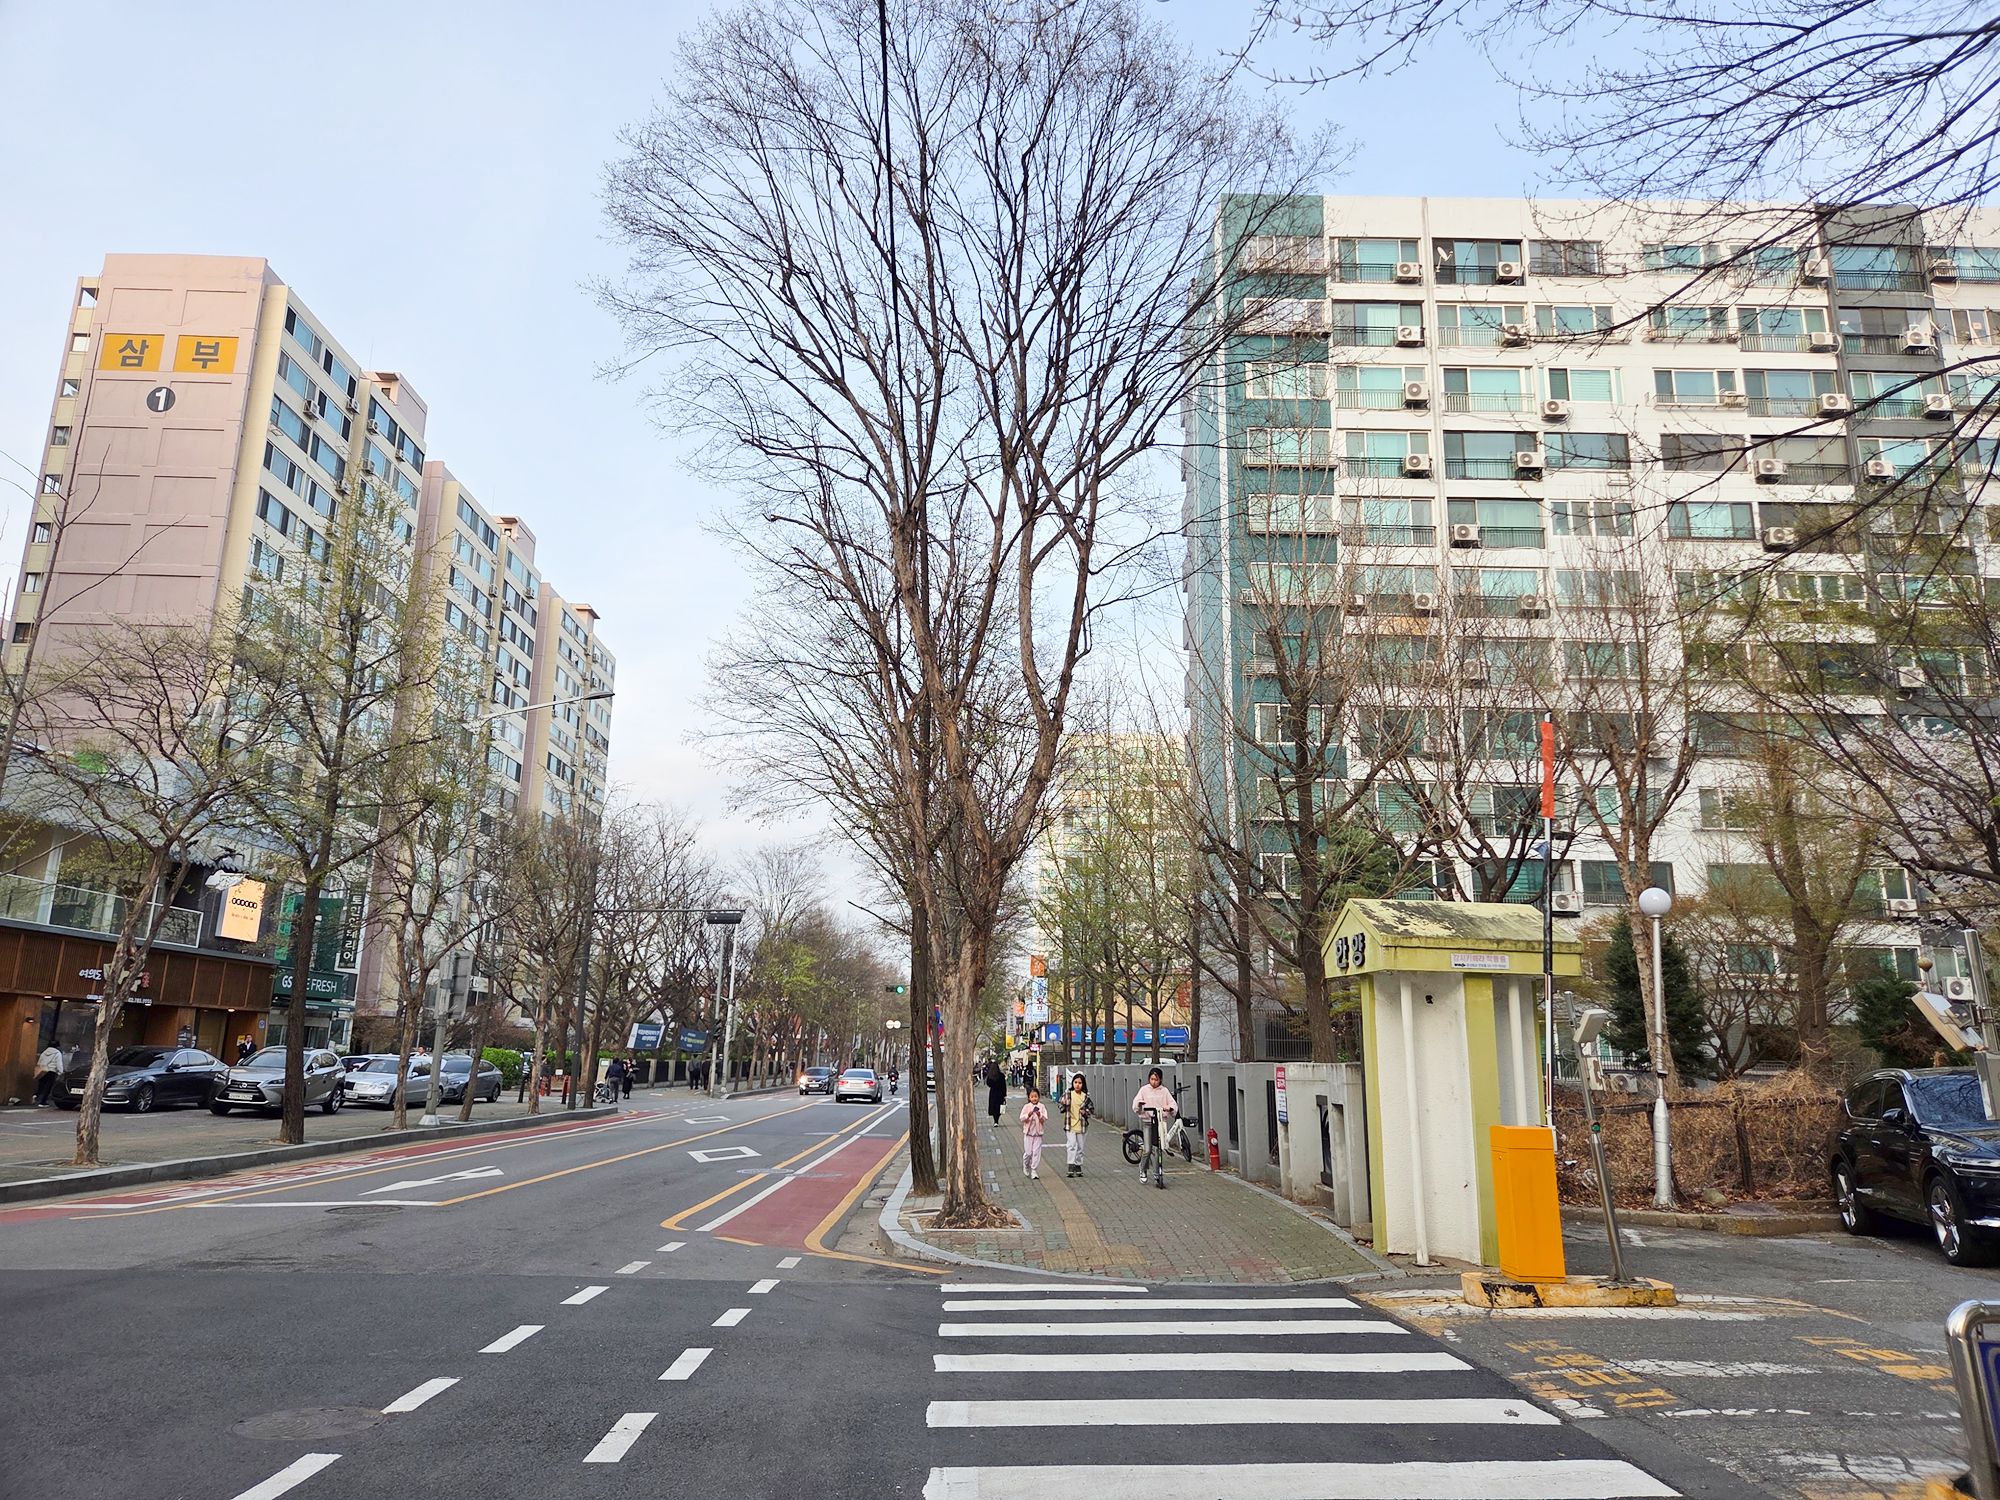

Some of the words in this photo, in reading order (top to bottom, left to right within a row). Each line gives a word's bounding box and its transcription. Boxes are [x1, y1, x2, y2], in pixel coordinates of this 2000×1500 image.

[118, 339, 220, 369] 삼부
[155, 388, 167, 411] 1
[1335, 933, 1365, 968] 한양
[281, 975, 293, 988] GS
[311, 979, 337, 992] FRESH
